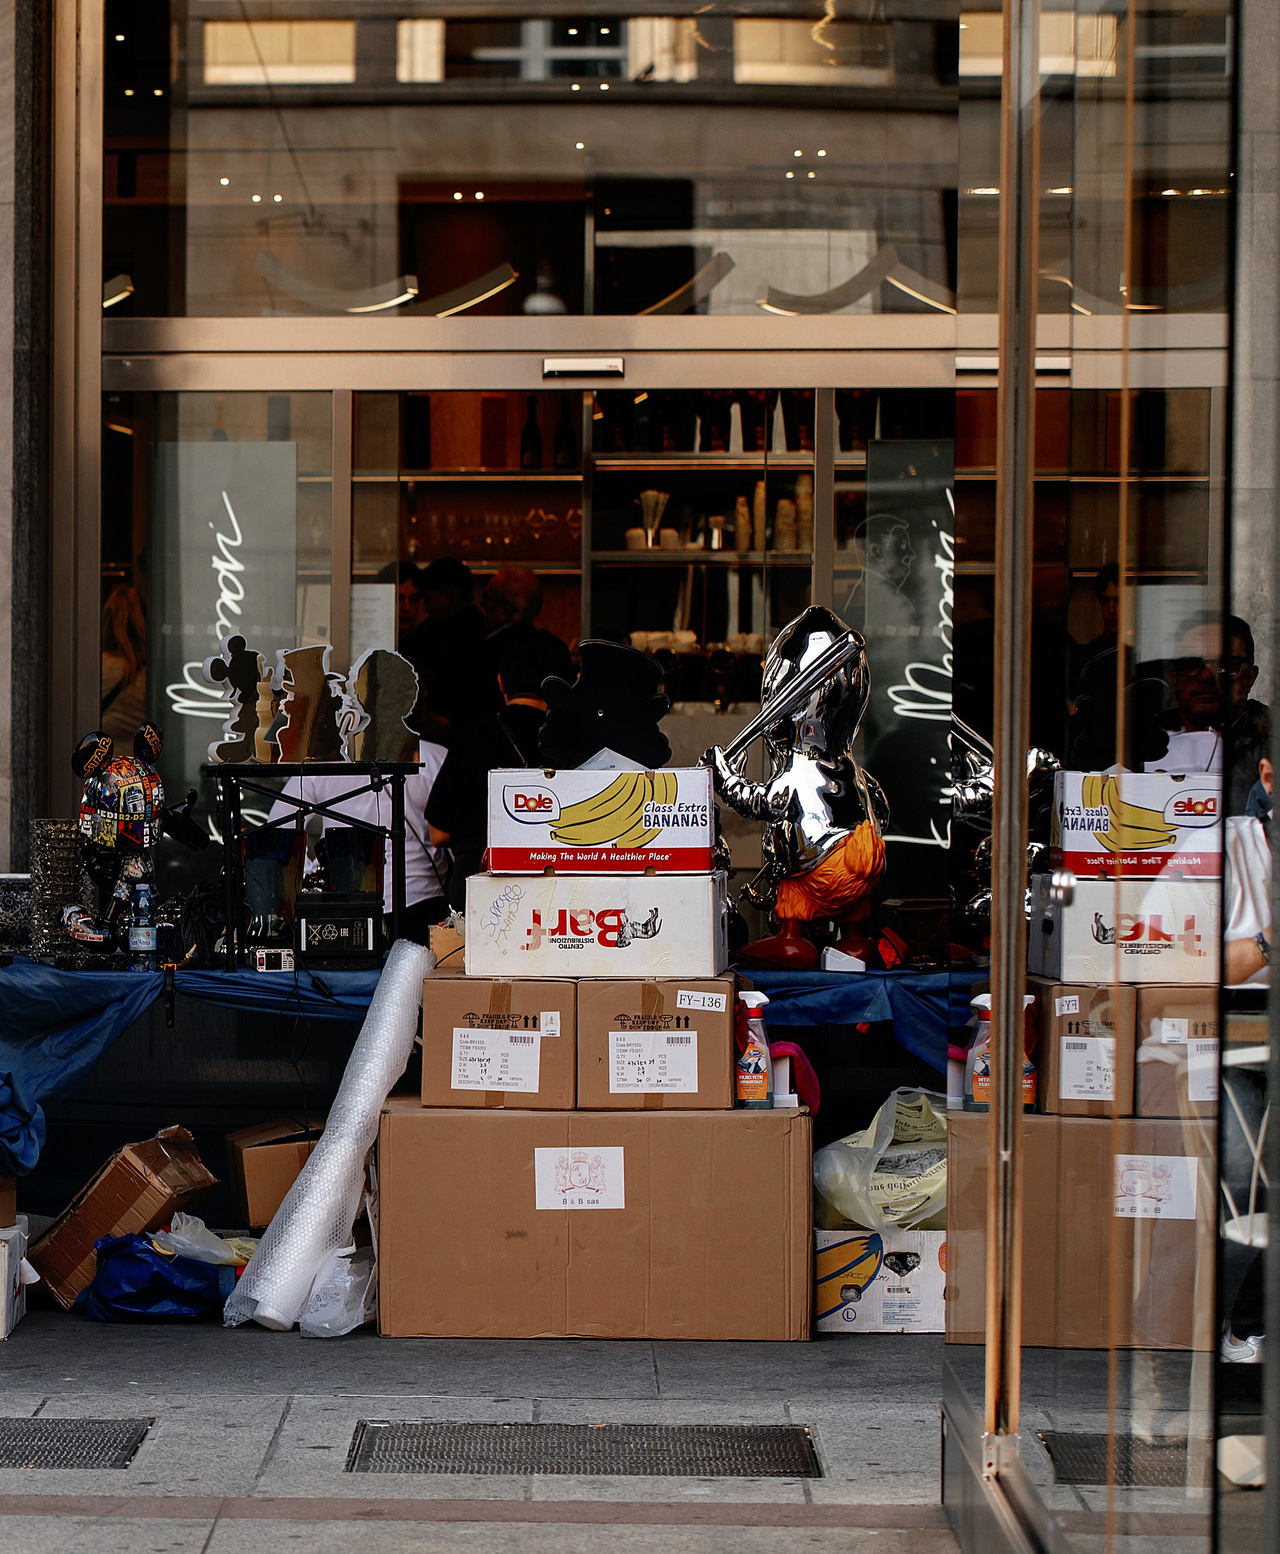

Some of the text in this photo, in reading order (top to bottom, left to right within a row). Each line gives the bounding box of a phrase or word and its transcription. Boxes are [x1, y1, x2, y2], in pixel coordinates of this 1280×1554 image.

[83, 737, 111, 777] STAR
[514, 793, 553, 811] Dole
[643, 802, 707, 813] Class Extra
[643, 814, 708, 828] BANANAS
[530, 852, 557, 862] Making
[560, 852, 575, 861] The
[577, 852, 598, 861] World
[601, 852, 607, 861] A
[610, 852, 646, 861] Healthier
[679, 994, 721, 1008] FY-136
[847, 1311, 852, 1319] L
